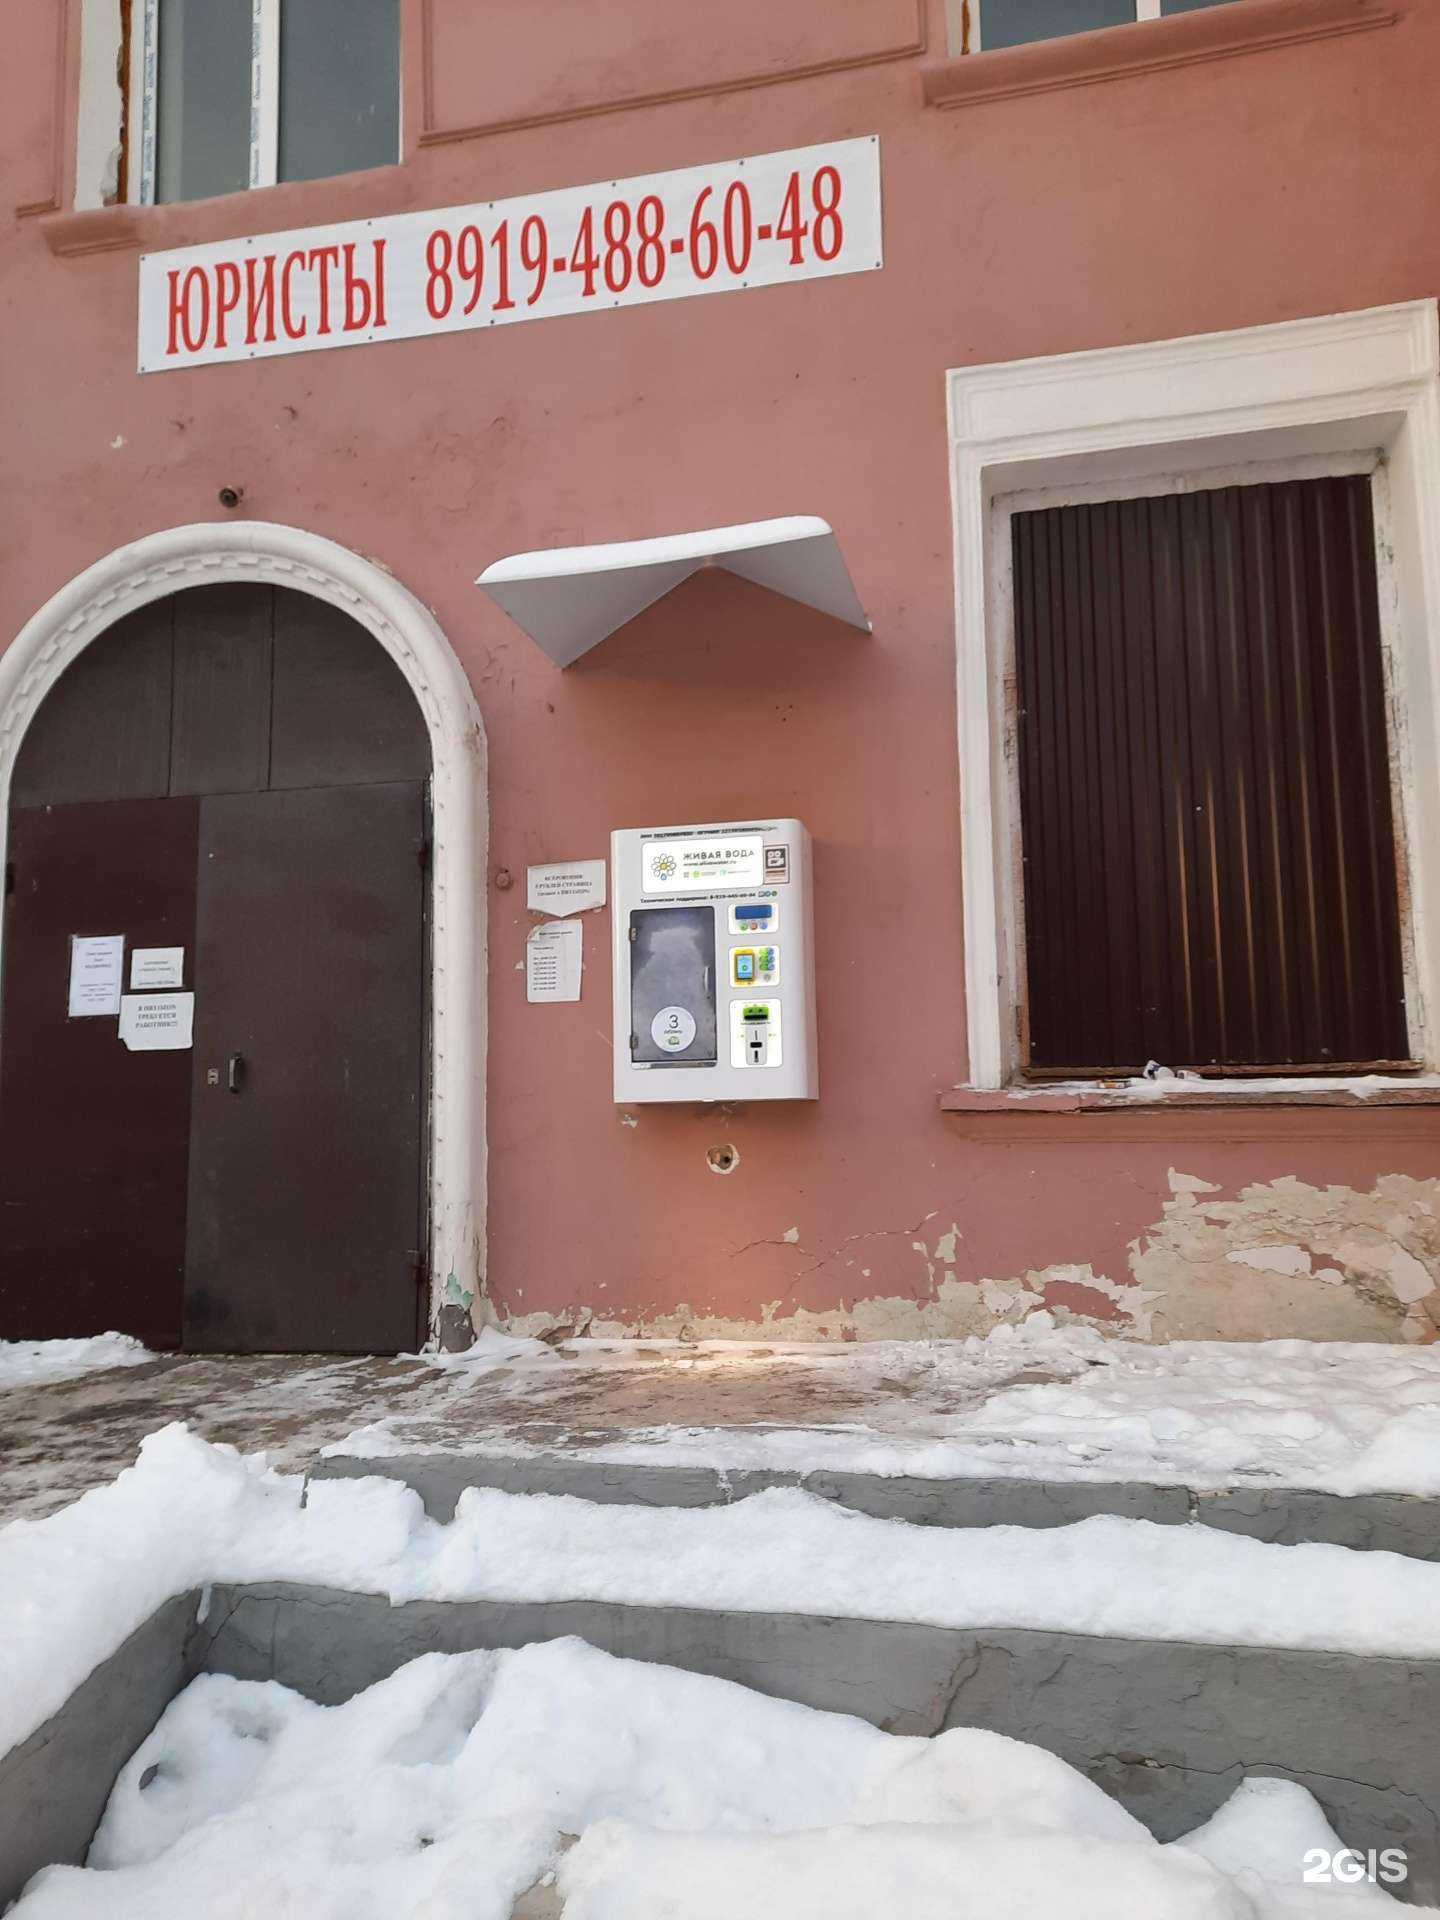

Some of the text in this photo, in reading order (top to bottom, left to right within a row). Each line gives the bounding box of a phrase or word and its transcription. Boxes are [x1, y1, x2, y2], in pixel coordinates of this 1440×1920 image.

[167, 166, 843, 354] ЮРИСТЫ 8919-488-60-48
[683, 849, 755, 861] ЖИВАЯ ВОДА
[669, 1014, 679, 1029] 3
